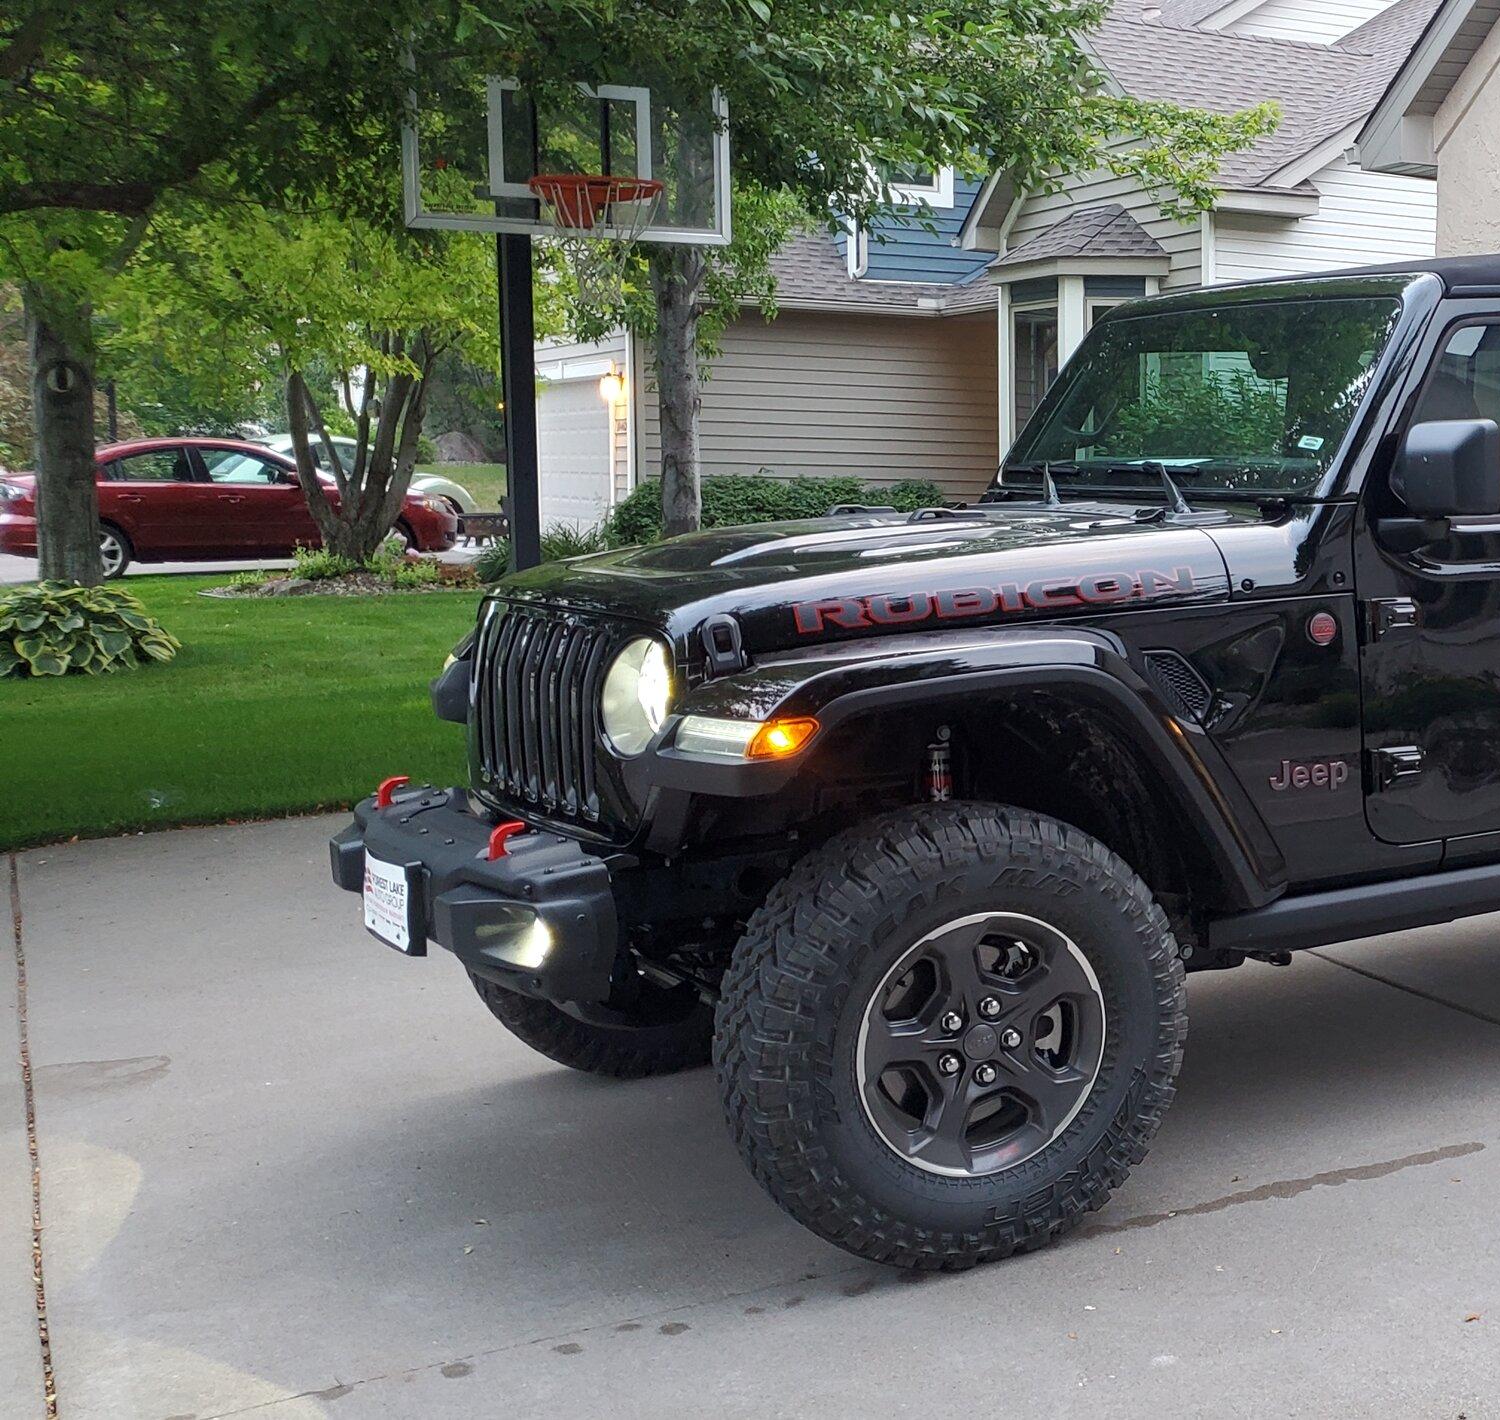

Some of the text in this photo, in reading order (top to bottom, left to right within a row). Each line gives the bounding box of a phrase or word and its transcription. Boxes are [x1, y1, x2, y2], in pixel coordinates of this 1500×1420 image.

[793, 566, 1196, 634] RUBICON
[1269, 760, 1349, 791] Jeep
[389, 881, 404, 896] LAKE
